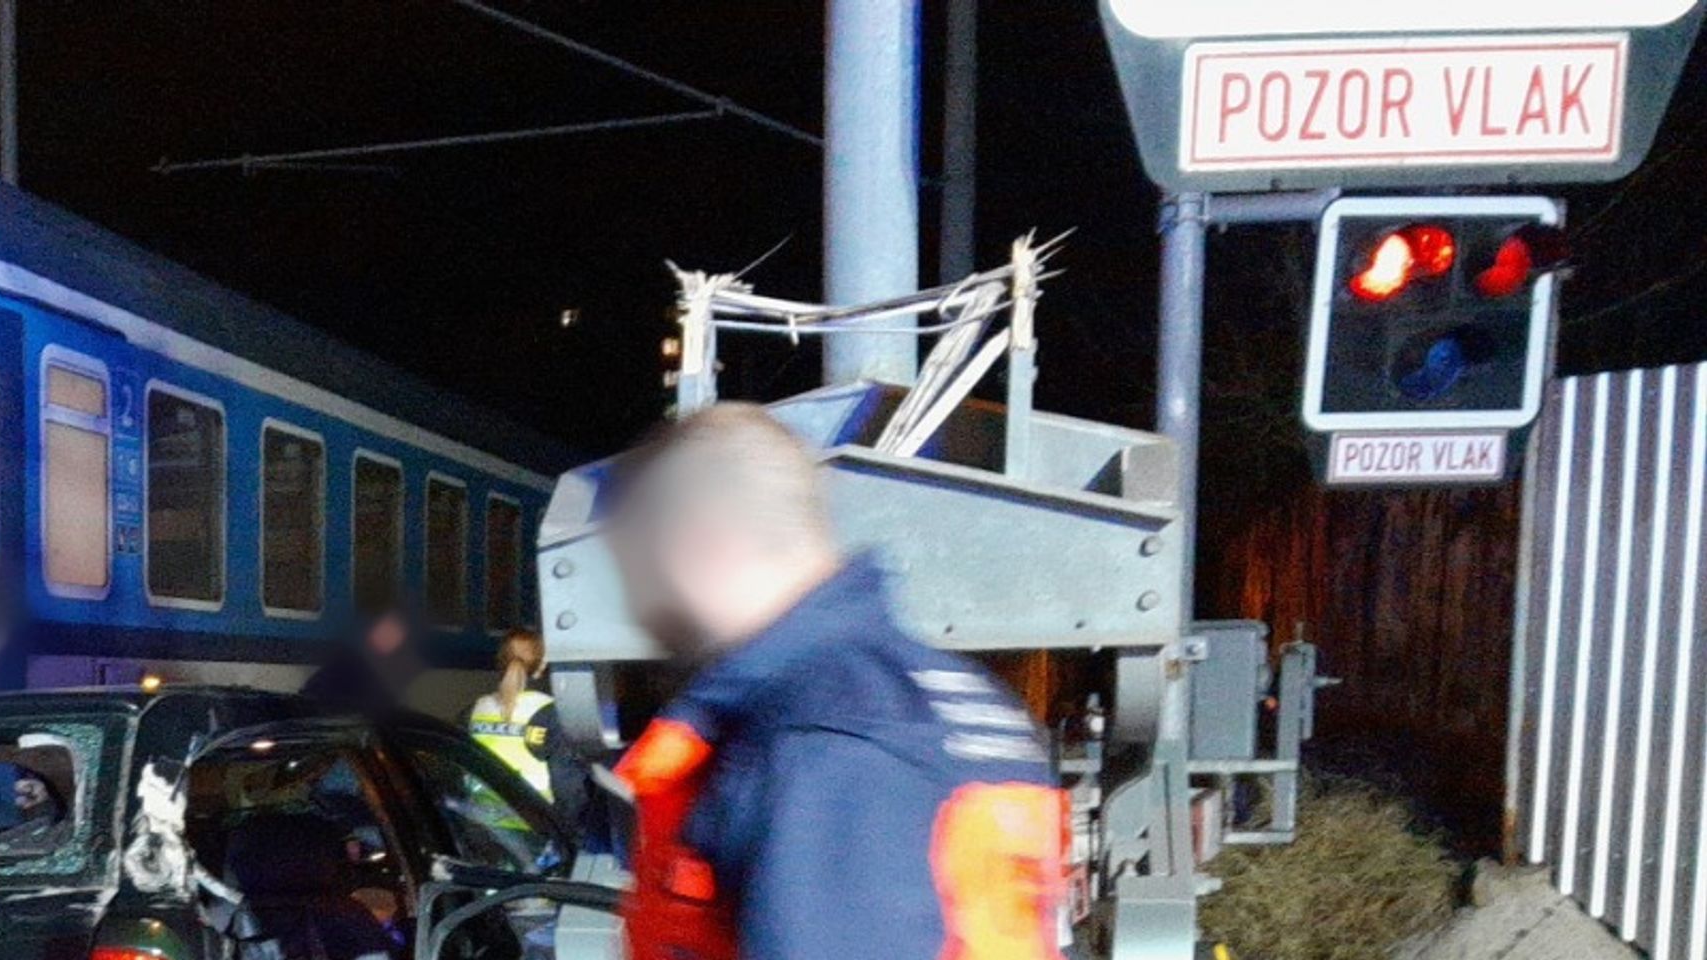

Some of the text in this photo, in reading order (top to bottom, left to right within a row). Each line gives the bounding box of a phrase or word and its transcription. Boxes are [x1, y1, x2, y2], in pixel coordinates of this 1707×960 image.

[1218, 63, 1595, 143] POZOR VLAK
[1344, 439, 1494, 472] POZOR VLAK
